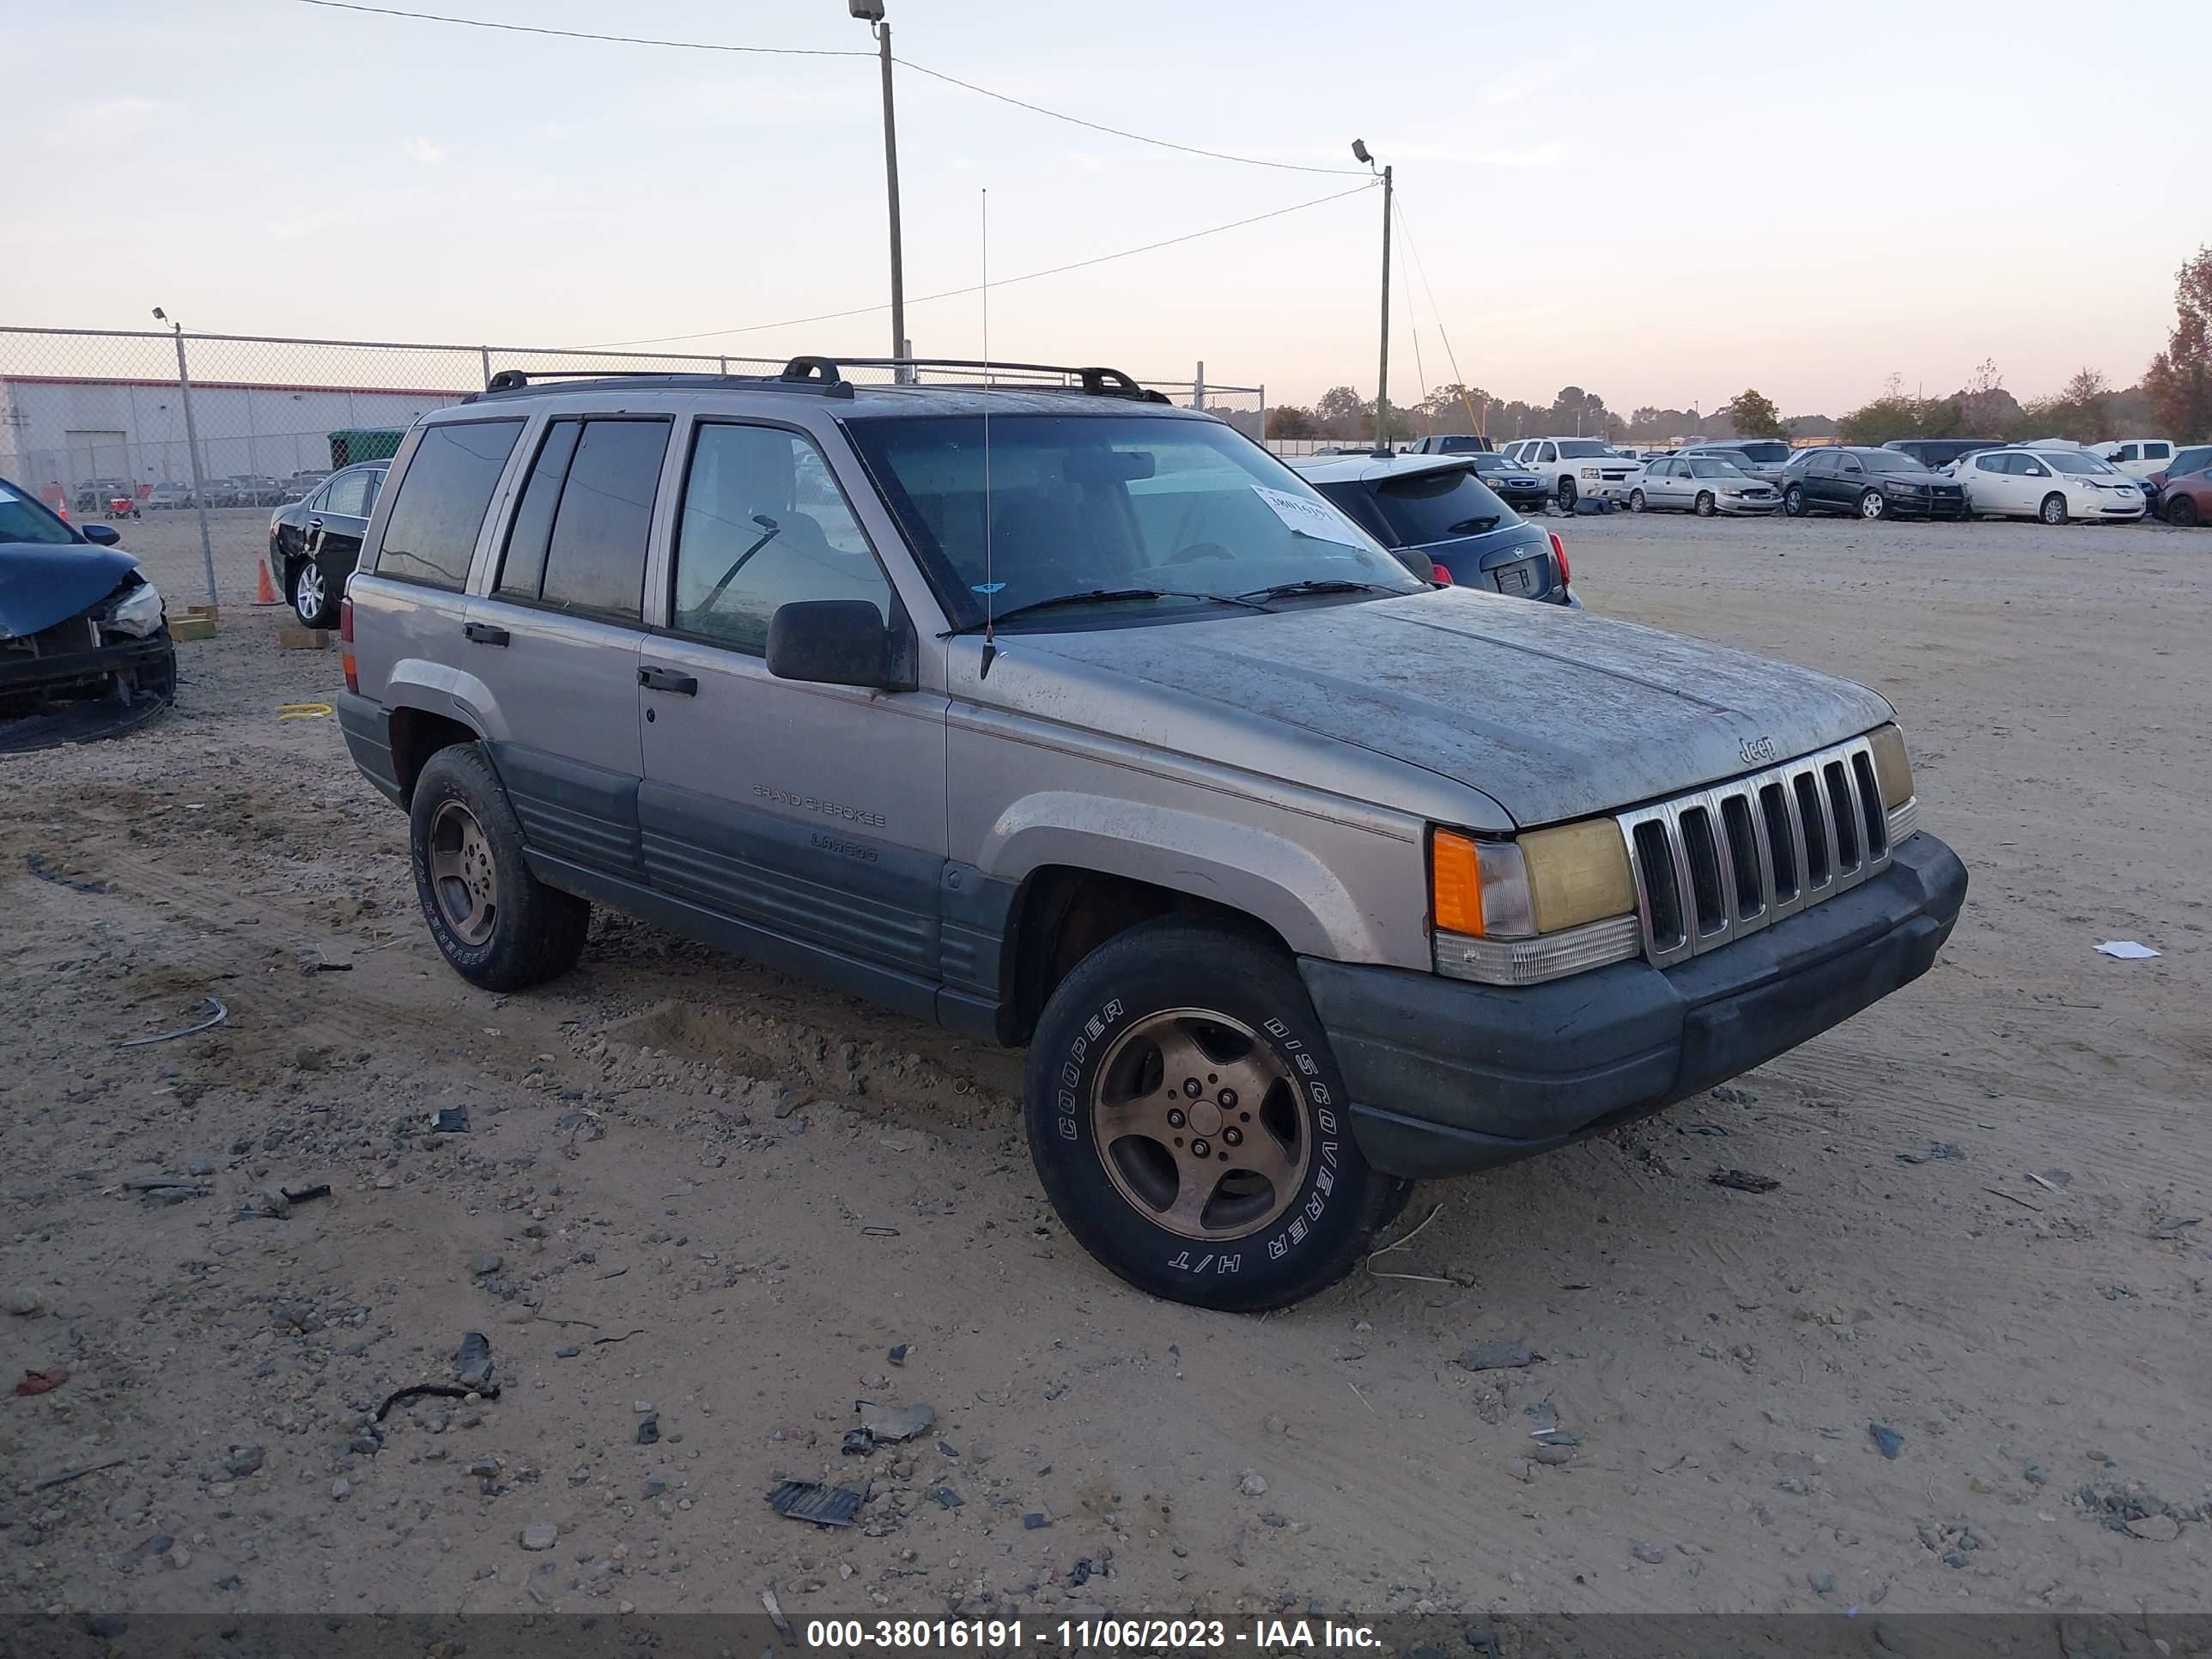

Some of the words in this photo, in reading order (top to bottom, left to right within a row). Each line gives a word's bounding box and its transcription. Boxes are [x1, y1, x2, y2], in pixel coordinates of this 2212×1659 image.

[1739, 736, 1776, 763] Jeep
[752, 784, 802, 807] GRAND
[805, 798, 886, 827] CHEROKEE
[811, 833, 878, 862] LAREDO
[1058, 998, 1124, 1140] COOPER
[1264, 1017, 1339, 1260] DISCOVERER
[1168, 1250, 1242, 1275] H/T
